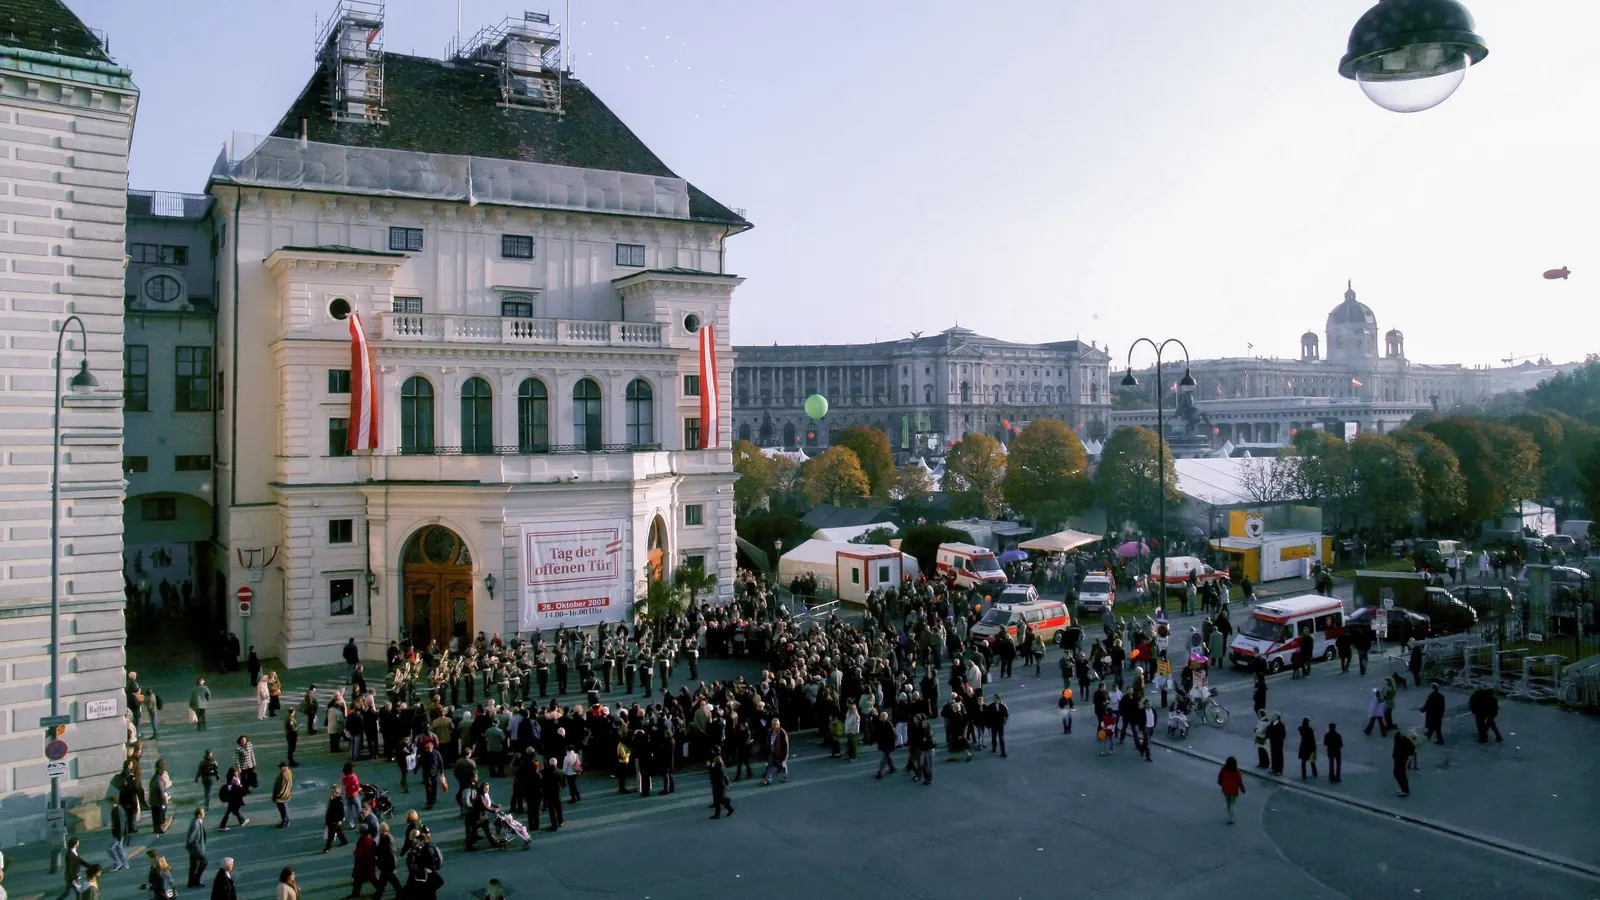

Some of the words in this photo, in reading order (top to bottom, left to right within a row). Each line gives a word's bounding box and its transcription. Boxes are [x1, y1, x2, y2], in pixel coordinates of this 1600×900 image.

[550, 547, 573, 561] Tag
[576, 545, 597, 558] der
[535, 563, 585, 576] offenen
[588, 560, 611, 572] Tür
[541, 603, 554, 611] 26.
[555, 599, 587, 609] Oktober
[588, 598, 606, 607] 2008
[589, 607, 603, 615] Uhr
